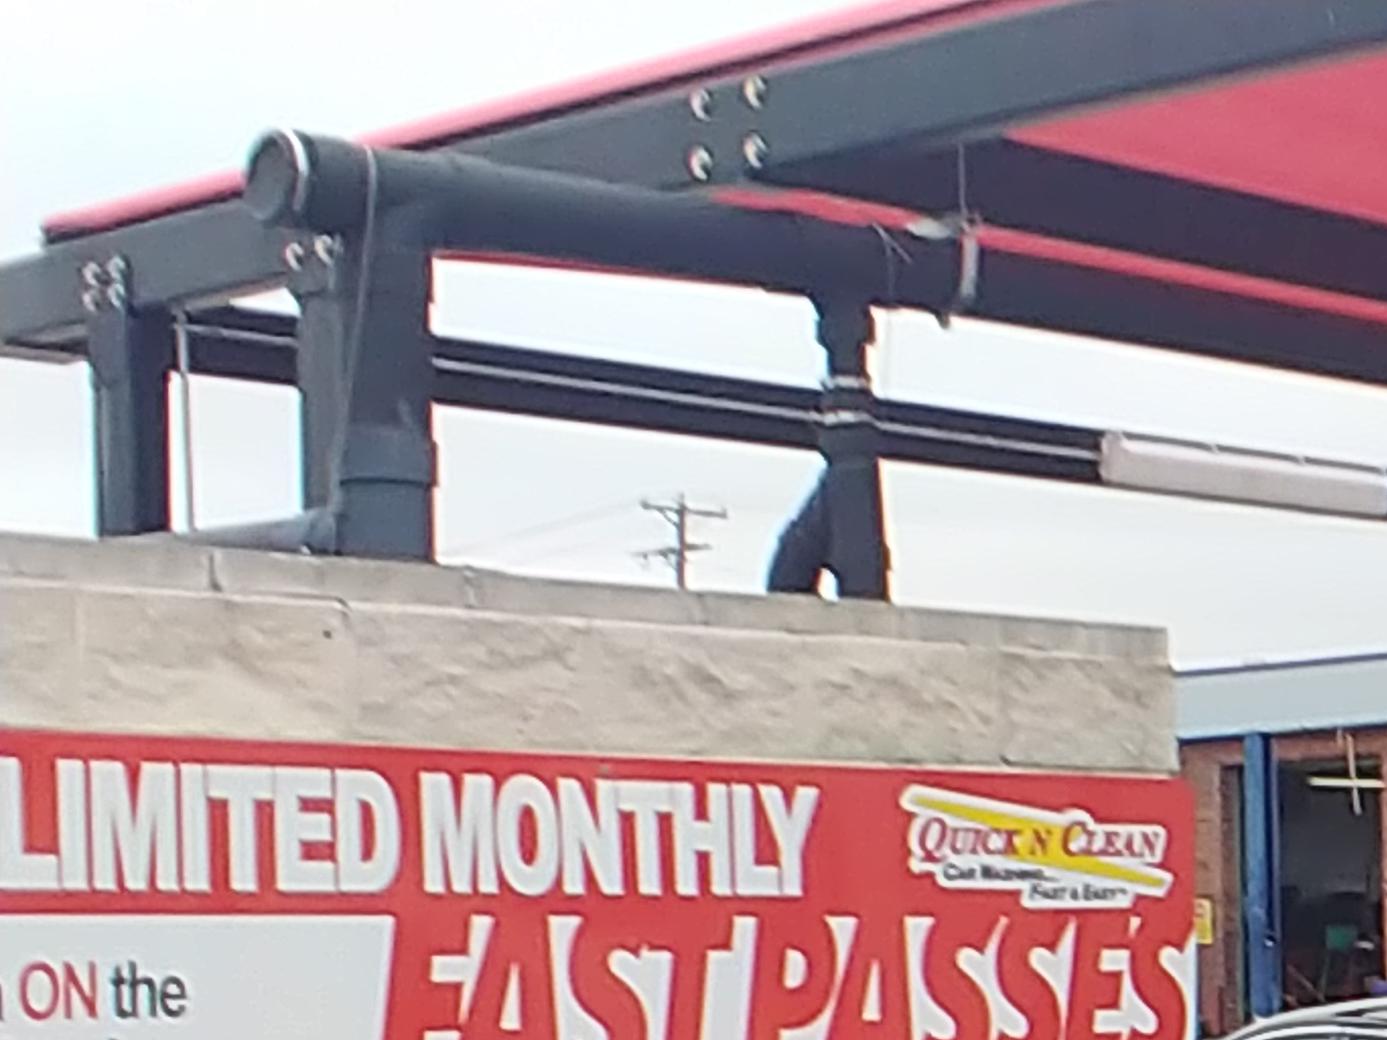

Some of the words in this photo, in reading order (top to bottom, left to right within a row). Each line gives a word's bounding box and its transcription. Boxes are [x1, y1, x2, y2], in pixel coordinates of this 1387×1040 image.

[0, 756, 400, 893] LIMITED
[419, 771, 820, 897] MONTHLY
[918, 817, 1024, 863] QUICK
[1061, 820, 1161, 858] CLEAN
[19, 960, 98, 1020] ON
[112, 960, 189, 1018] the
